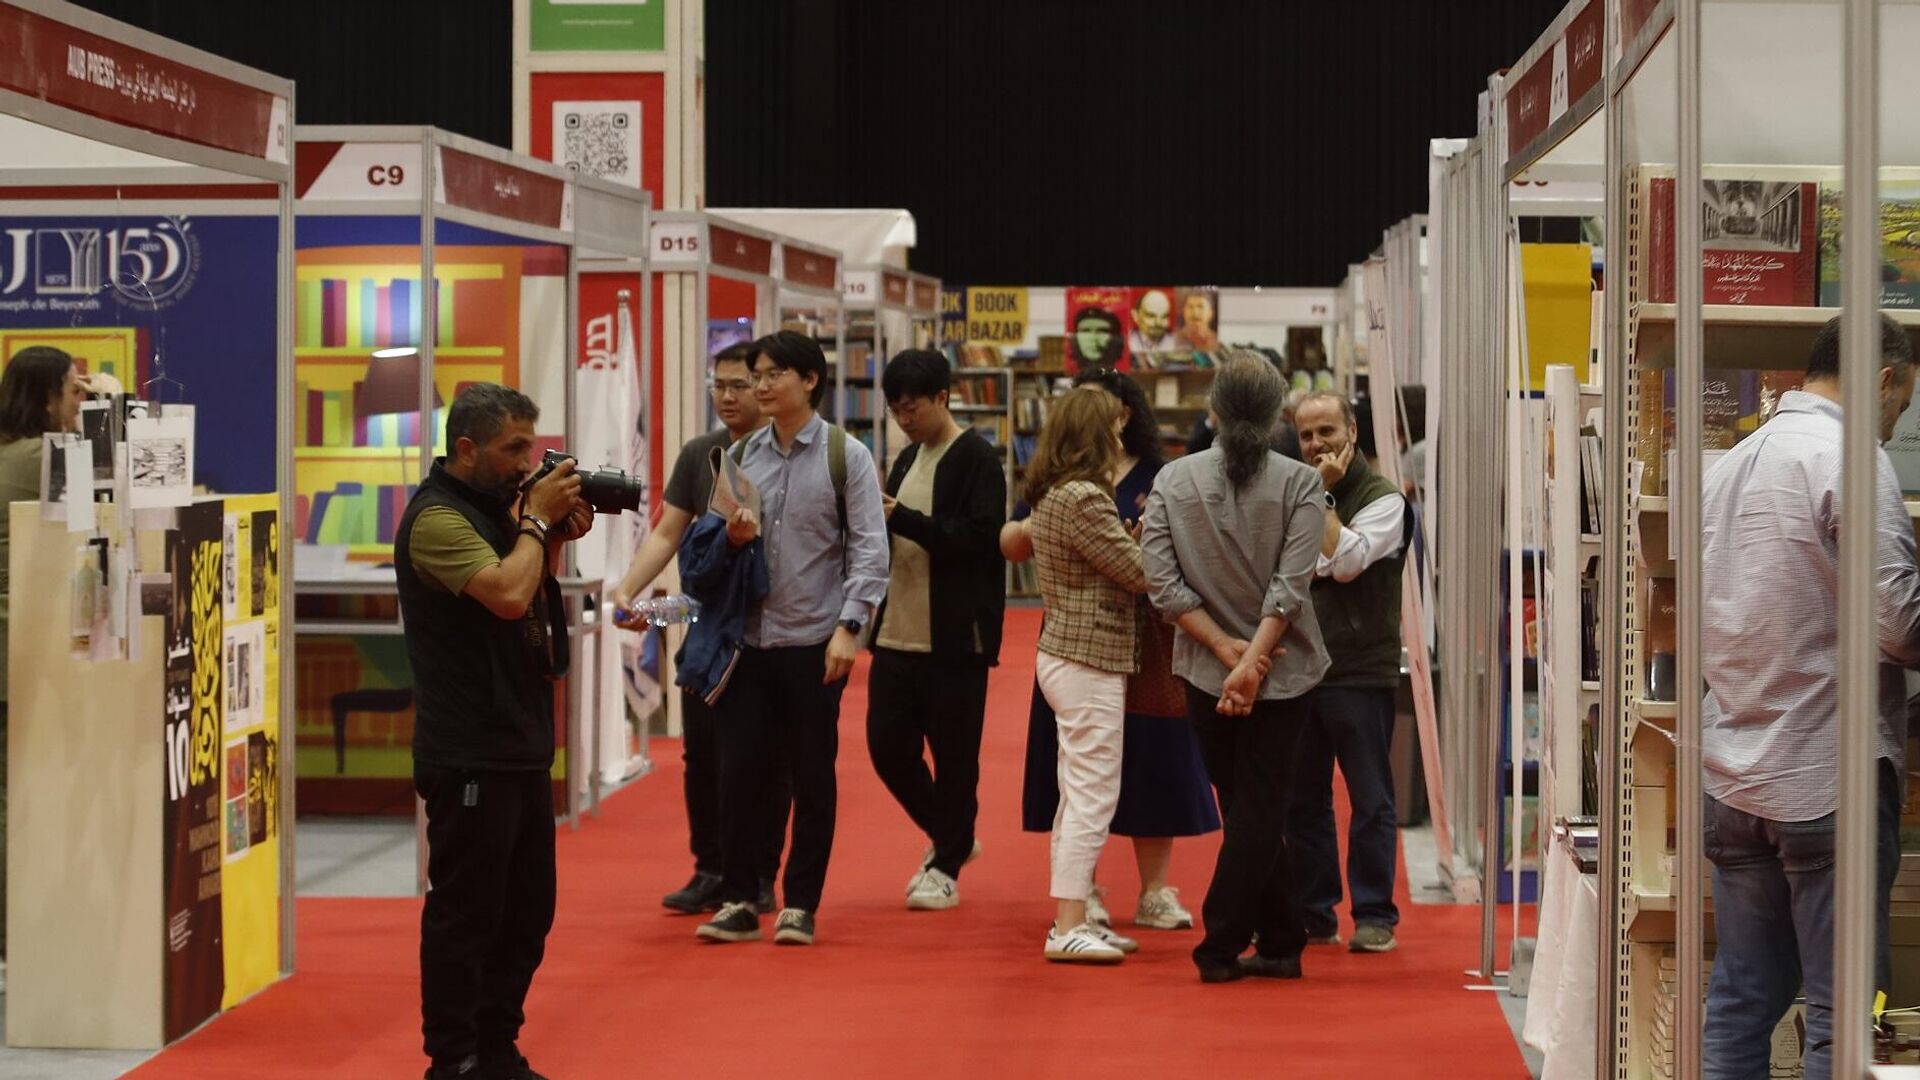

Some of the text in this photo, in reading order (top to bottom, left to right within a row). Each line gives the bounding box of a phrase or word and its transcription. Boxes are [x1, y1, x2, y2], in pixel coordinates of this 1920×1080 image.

[67, 44, 115, 90] AUB PRESS
[367, 165, 404, 186] C9
[661, 237, 698, 251] D15
[975, 293, 1018, 313] BOOK
[970, 321, 1022, 341] BAZAR
[167, 719, 190, 800] 10
